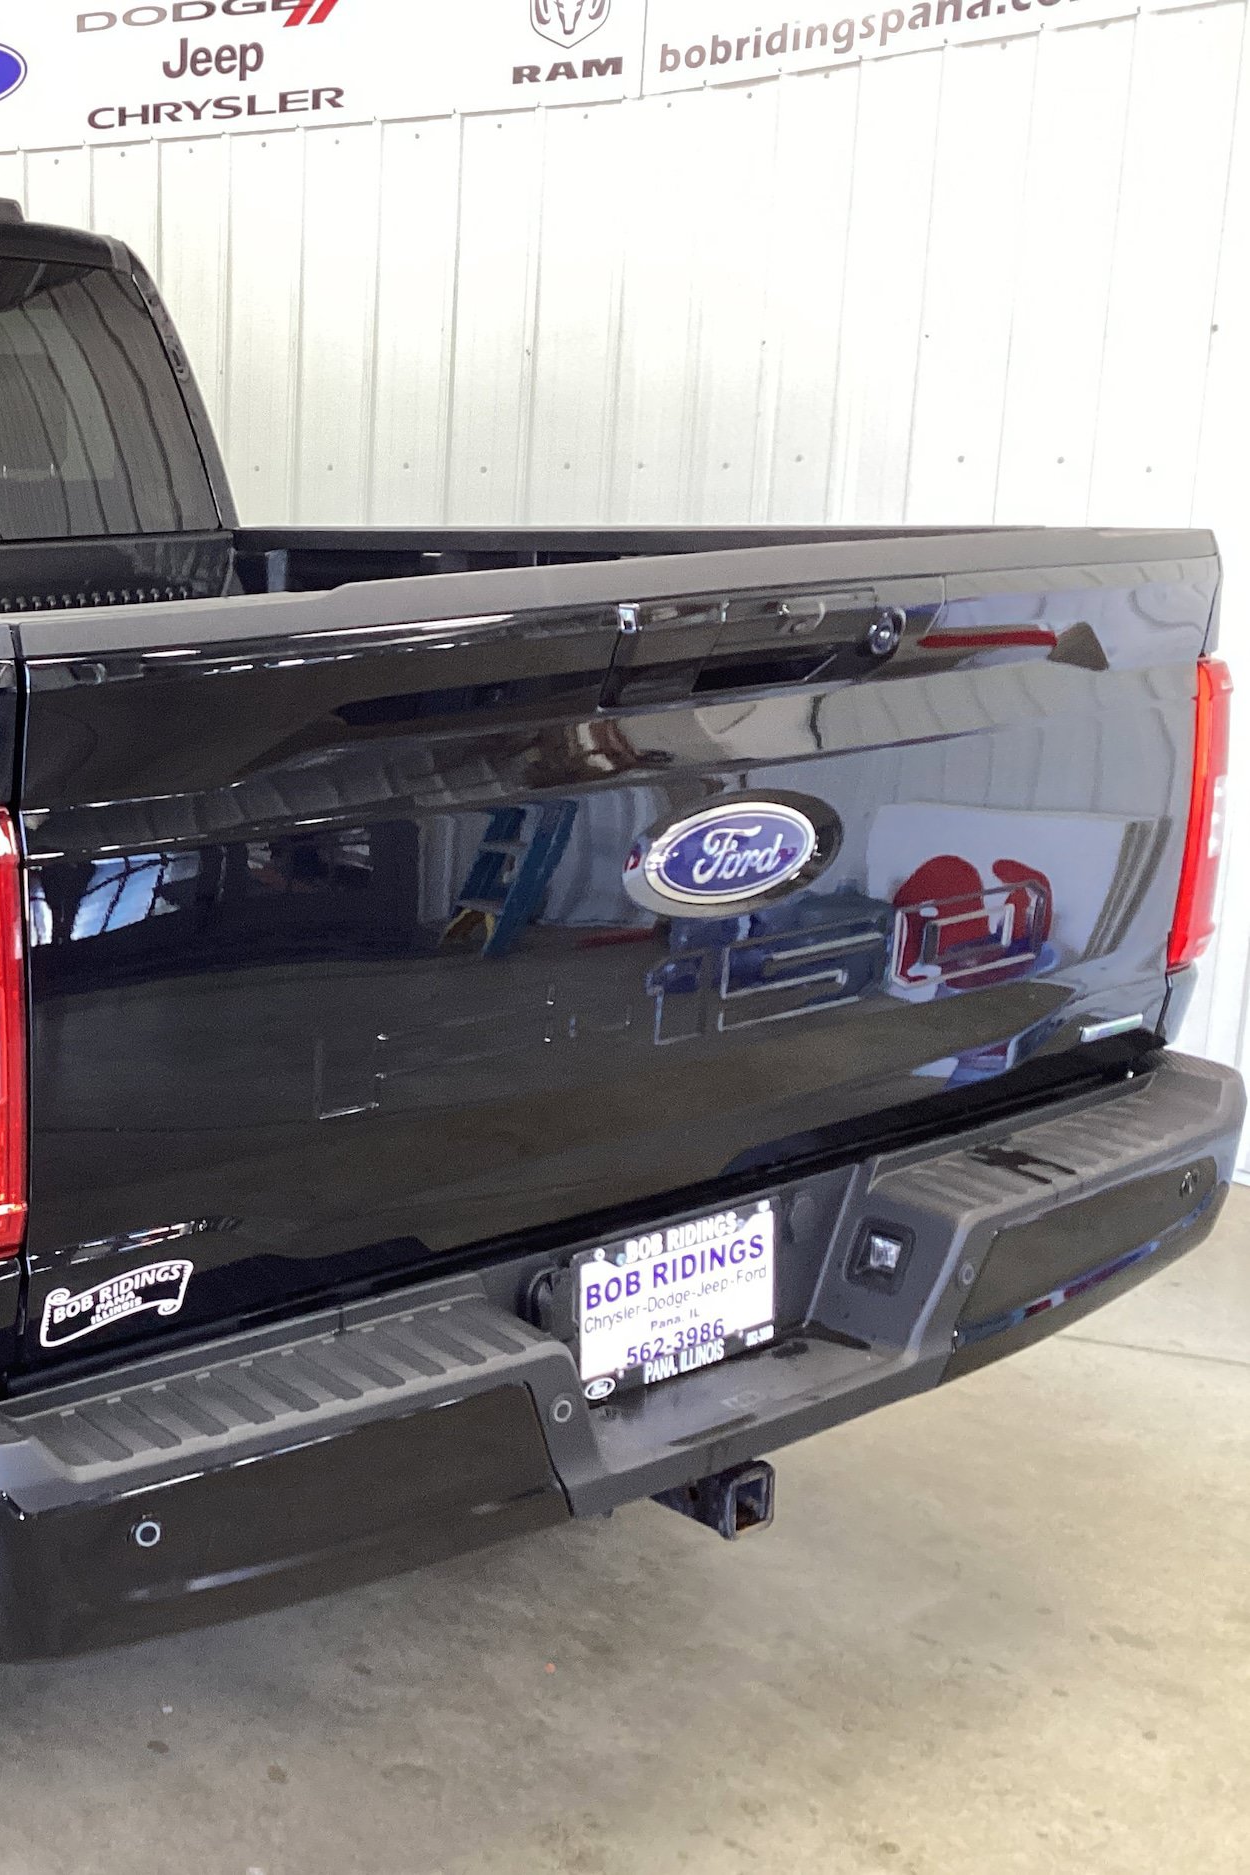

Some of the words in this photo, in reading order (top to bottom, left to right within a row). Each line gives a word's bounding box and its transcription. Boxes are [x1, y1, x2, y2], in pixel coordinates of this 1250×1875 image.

[658, 0, 1080, 73] bobridingspana.
[162, 38, 264, 81] Jeep
[511, 56, 624, 84] RAM
[87, 87, 345, 130] CHRYSLER
[692, 824, 784, 885] Ford
[625, 1233, 664, 1265] BOB
[667, 1211, 738, 1252] RIDINGS
[52, 1294, 95, 1324] BOB
[99, 1264, 183, 1303] RIDINGS
[585, 1270, 642, 1311] BOB
[652, 1234, 765, 1289] RIDINGS
[90, 1296, 143, 1325] ILLINOIS
[95, 1291, 136, 1314] PANA
[689, 1308, 700, 1319] IL
[626, 1318, 725, 1369] 562-3986
[679, 1338, 725, 1371] ILLINOIS
